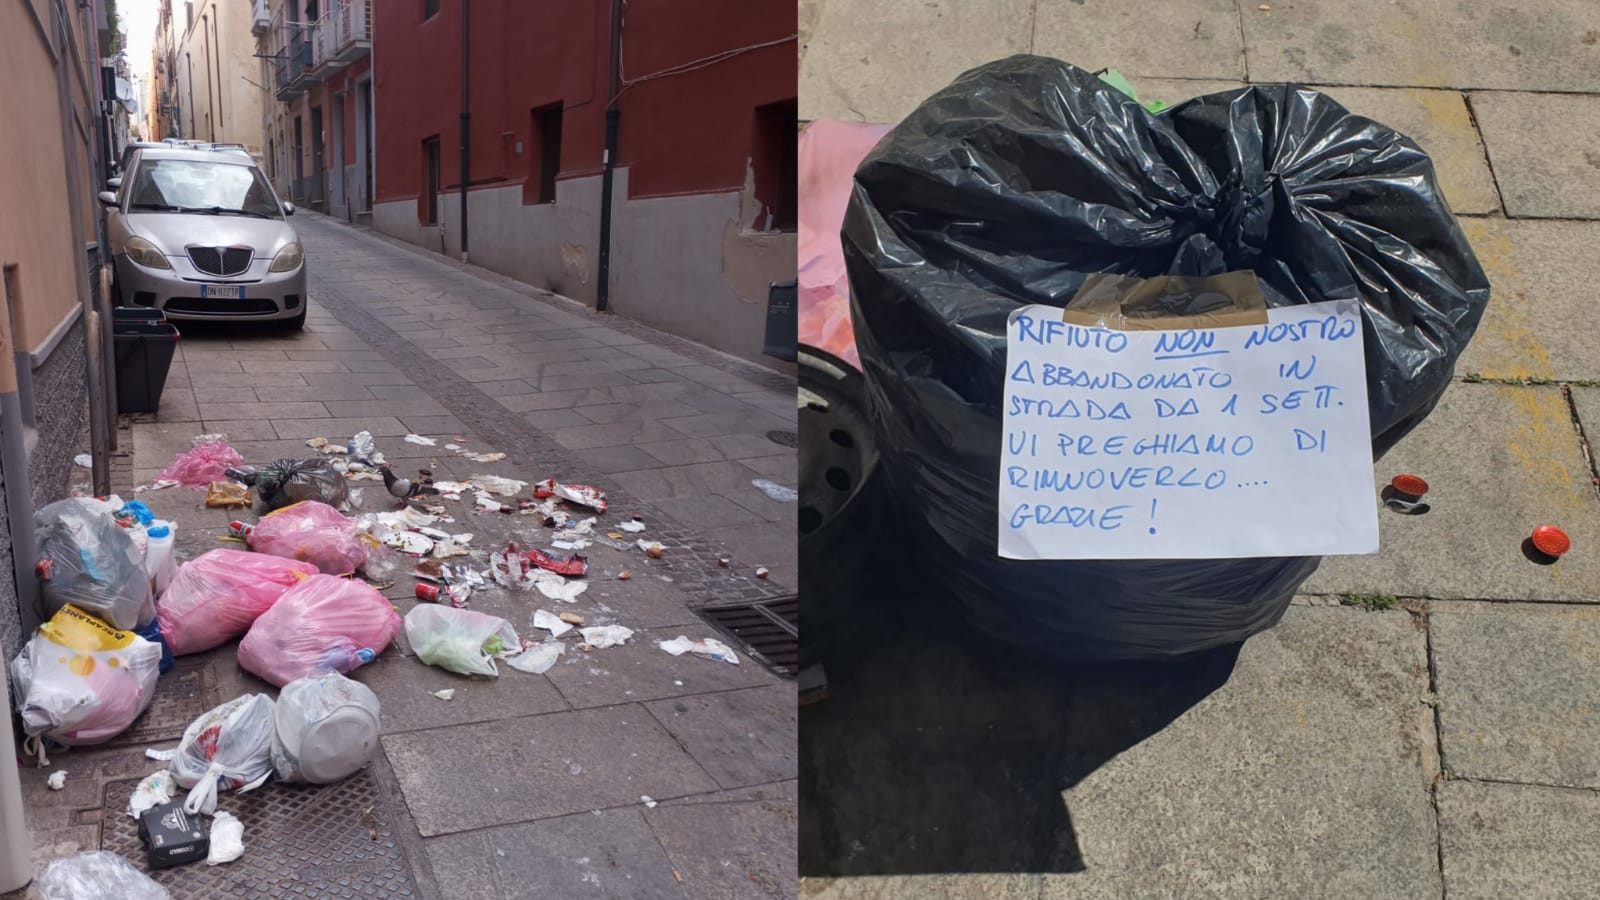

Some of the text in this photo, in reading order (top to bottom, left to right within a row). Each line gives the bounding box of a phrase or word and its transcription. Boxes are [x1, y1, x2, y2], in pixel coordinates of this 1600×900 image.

[1015, 314, 1357, 355] RIFIUTO NON NOSTRO
[1010, 354, 1318, 390] ABBANDONATO IN
[1008, 395, 1132, 421] STRADA
[1155, 398, 1201, 418] DA
[1220, 393, 1239, 417] 1
[1056, 433, 1255, 457] PREGHIAMO
[1293, 427, 1328, 453] DI
[1009, 503, 1135, 530] GRAZIE
